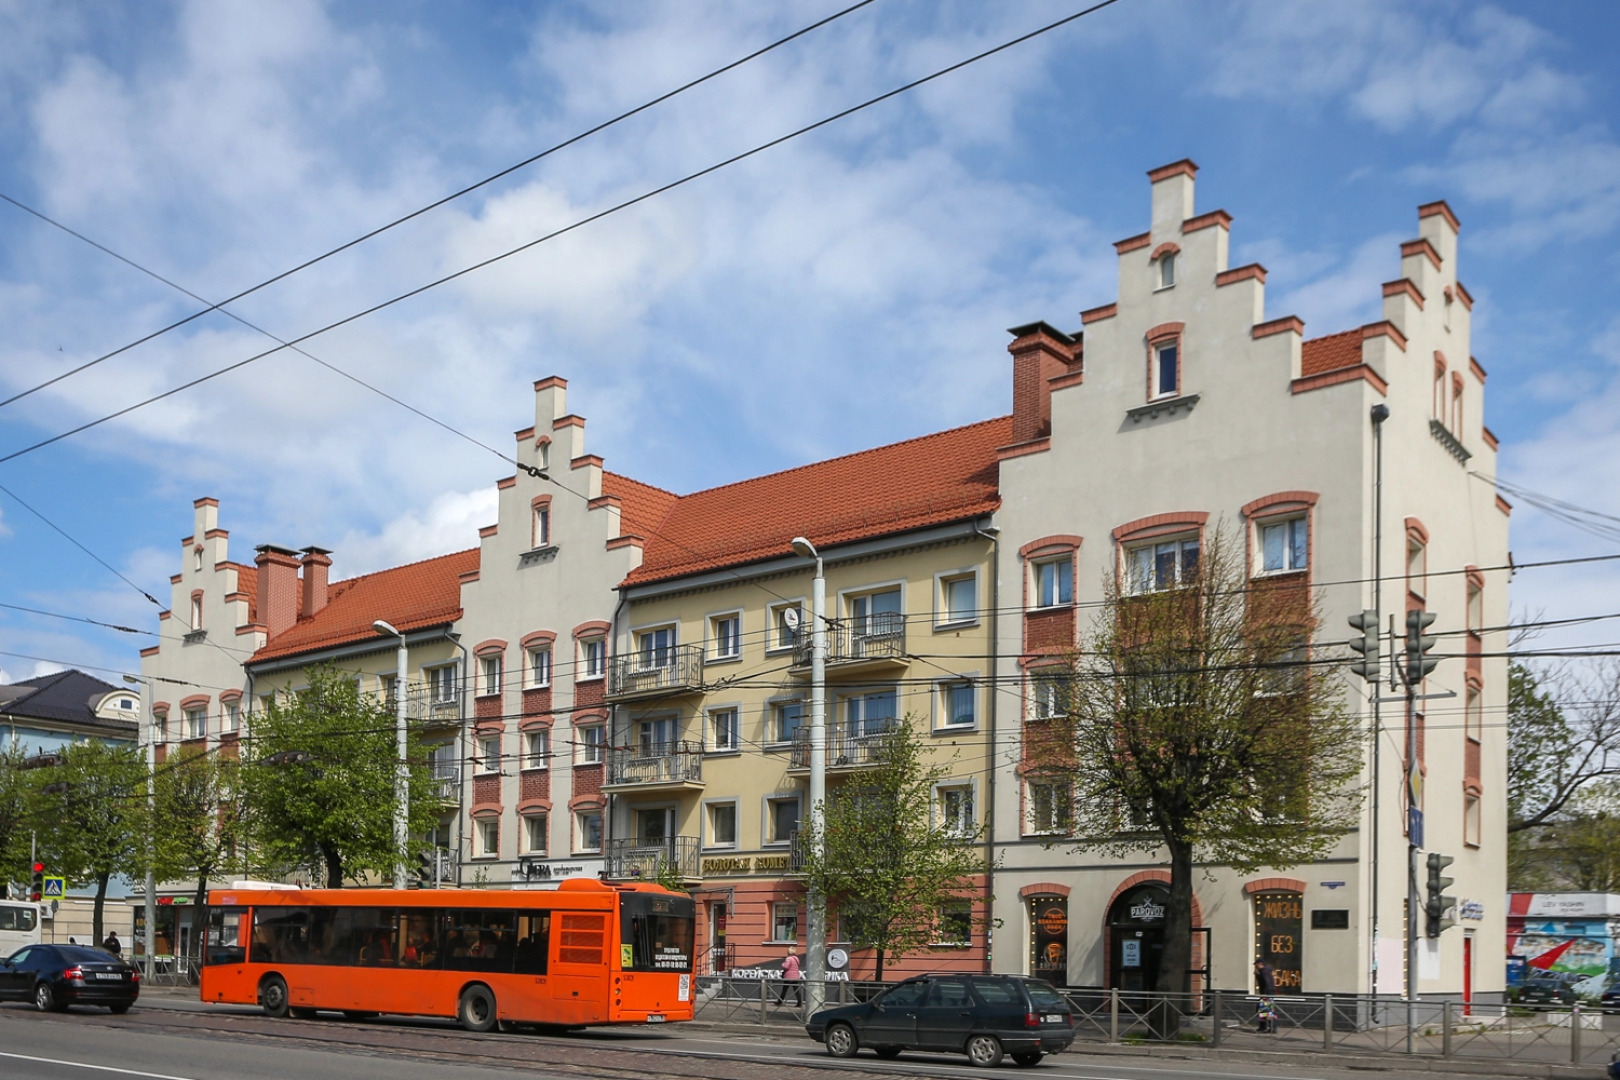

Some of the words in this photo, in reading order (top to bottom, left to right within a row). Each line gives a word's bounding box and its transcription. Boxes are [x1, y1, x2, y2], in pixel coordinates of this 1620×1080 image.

[1131, 906, 1165, 917] PAROVOZ
[1264, 902, 1302, 919] ЖИЗНЬ
[1271, 935, 1293, 953] БЕЗ
